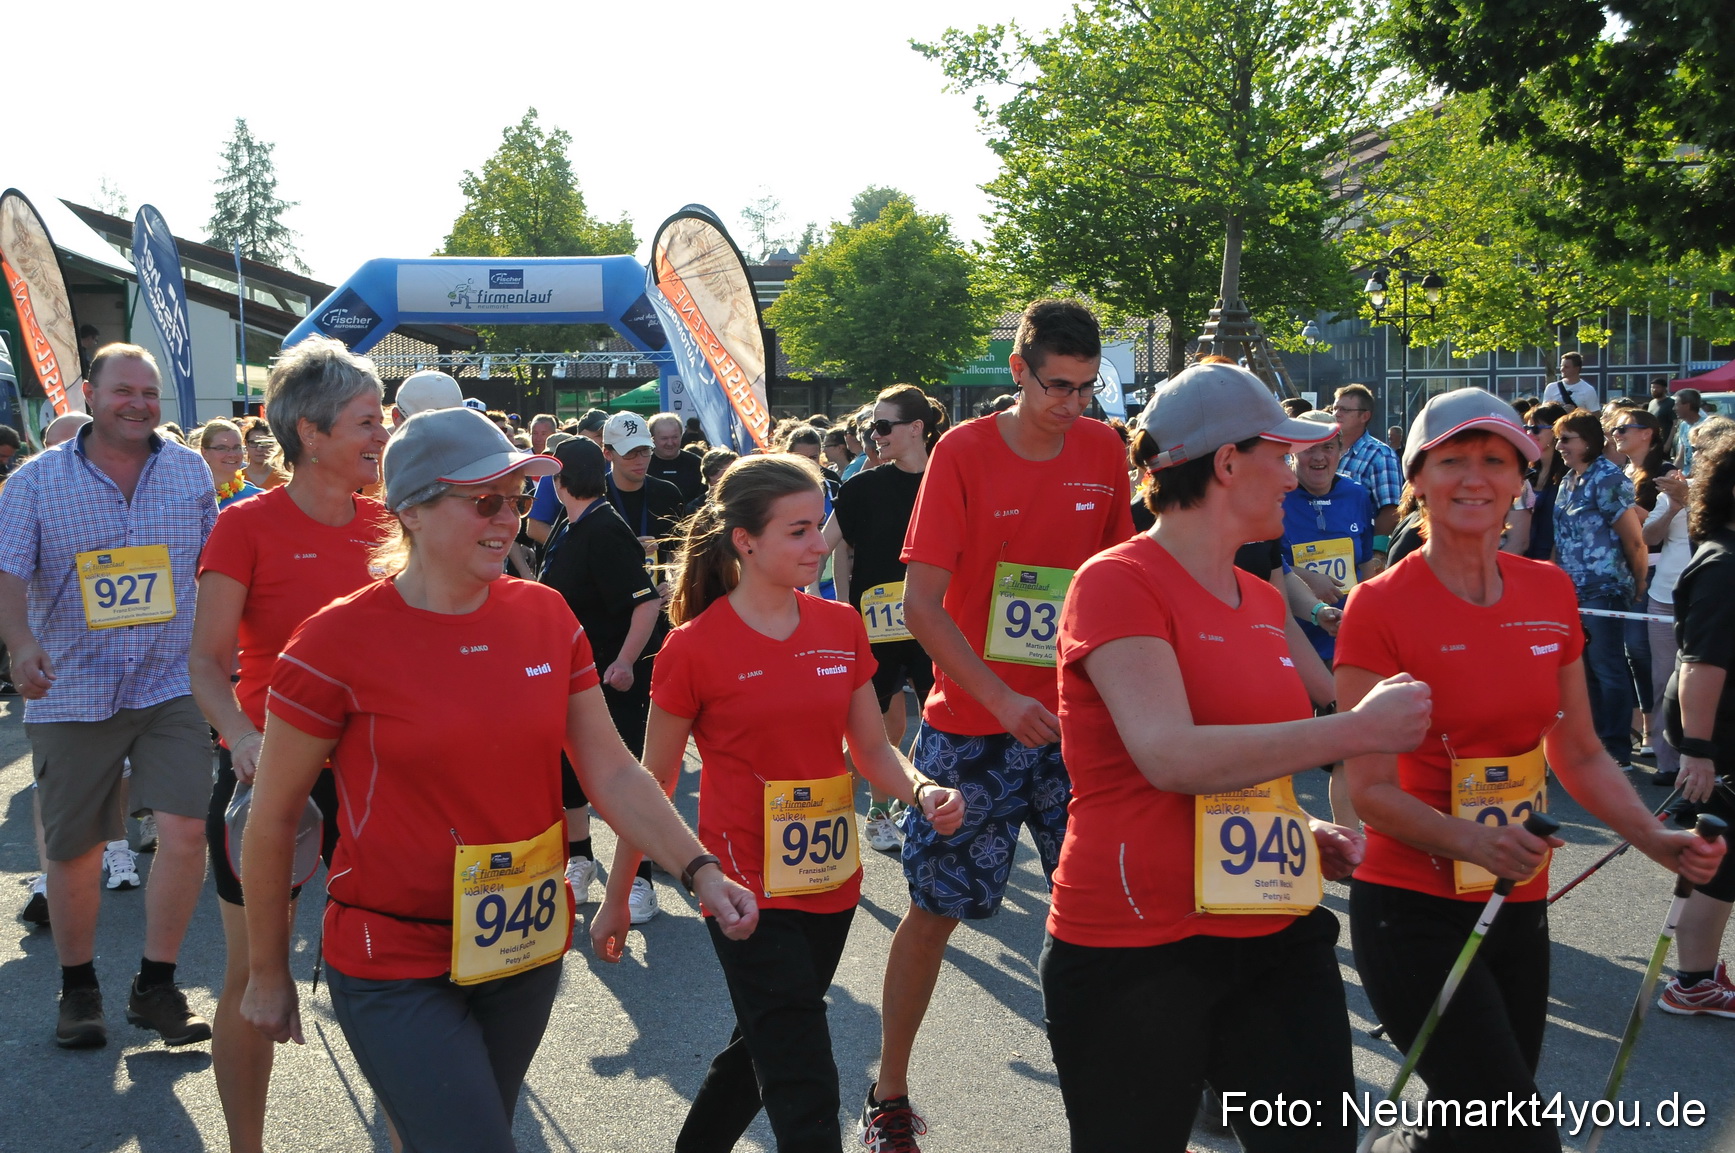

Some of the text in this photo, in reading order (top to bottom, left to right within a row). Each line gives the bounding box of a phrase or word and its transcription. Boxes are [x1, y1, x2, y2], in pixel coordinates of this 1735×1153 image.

[477, 289, 553, 303] firmenlauf
[330, 315, 373, 325] Fischer
[1075, 501, 1095, 511] Martin
[1003, 509, 1020, 517] JAKO
[95, 573, 157, 608] 927
[1005, 600, 1060, 642] 93
[470, 644, 489, 653] JAKO
[1026, 642, 1045, 650] Martin
[525, 662, 552, 677] Heidi
[747, 670, 764, 679] JAKO
[816, 664, 848, 677] Franziska
[1475, 776, 1526, 791] firmenlauf
[785, 797, 825, 809] firmenlauf
[1461, 796, 1504, 807] walken
[1205, 803, 1251, 816] walken
[772, 812, 806, 823] walken
[782, 816, 848, 866] 950
[1220, 816, 1306, 877] 949
[479, 861, 527, 879] firmenlauf
[798, 866, 826, 875] Franziska
[808, 876, 823, 884] Petry
[1254, 879, 1279, 888] Steffi
[464, 882, 505, 897] walken
[1262, 892, 1283, 902] Petry
[474, 878, 557, 947] 948
[500, 940, 536, 955] Heidi Fuchs
[505, 956, 521, 965] Petry
